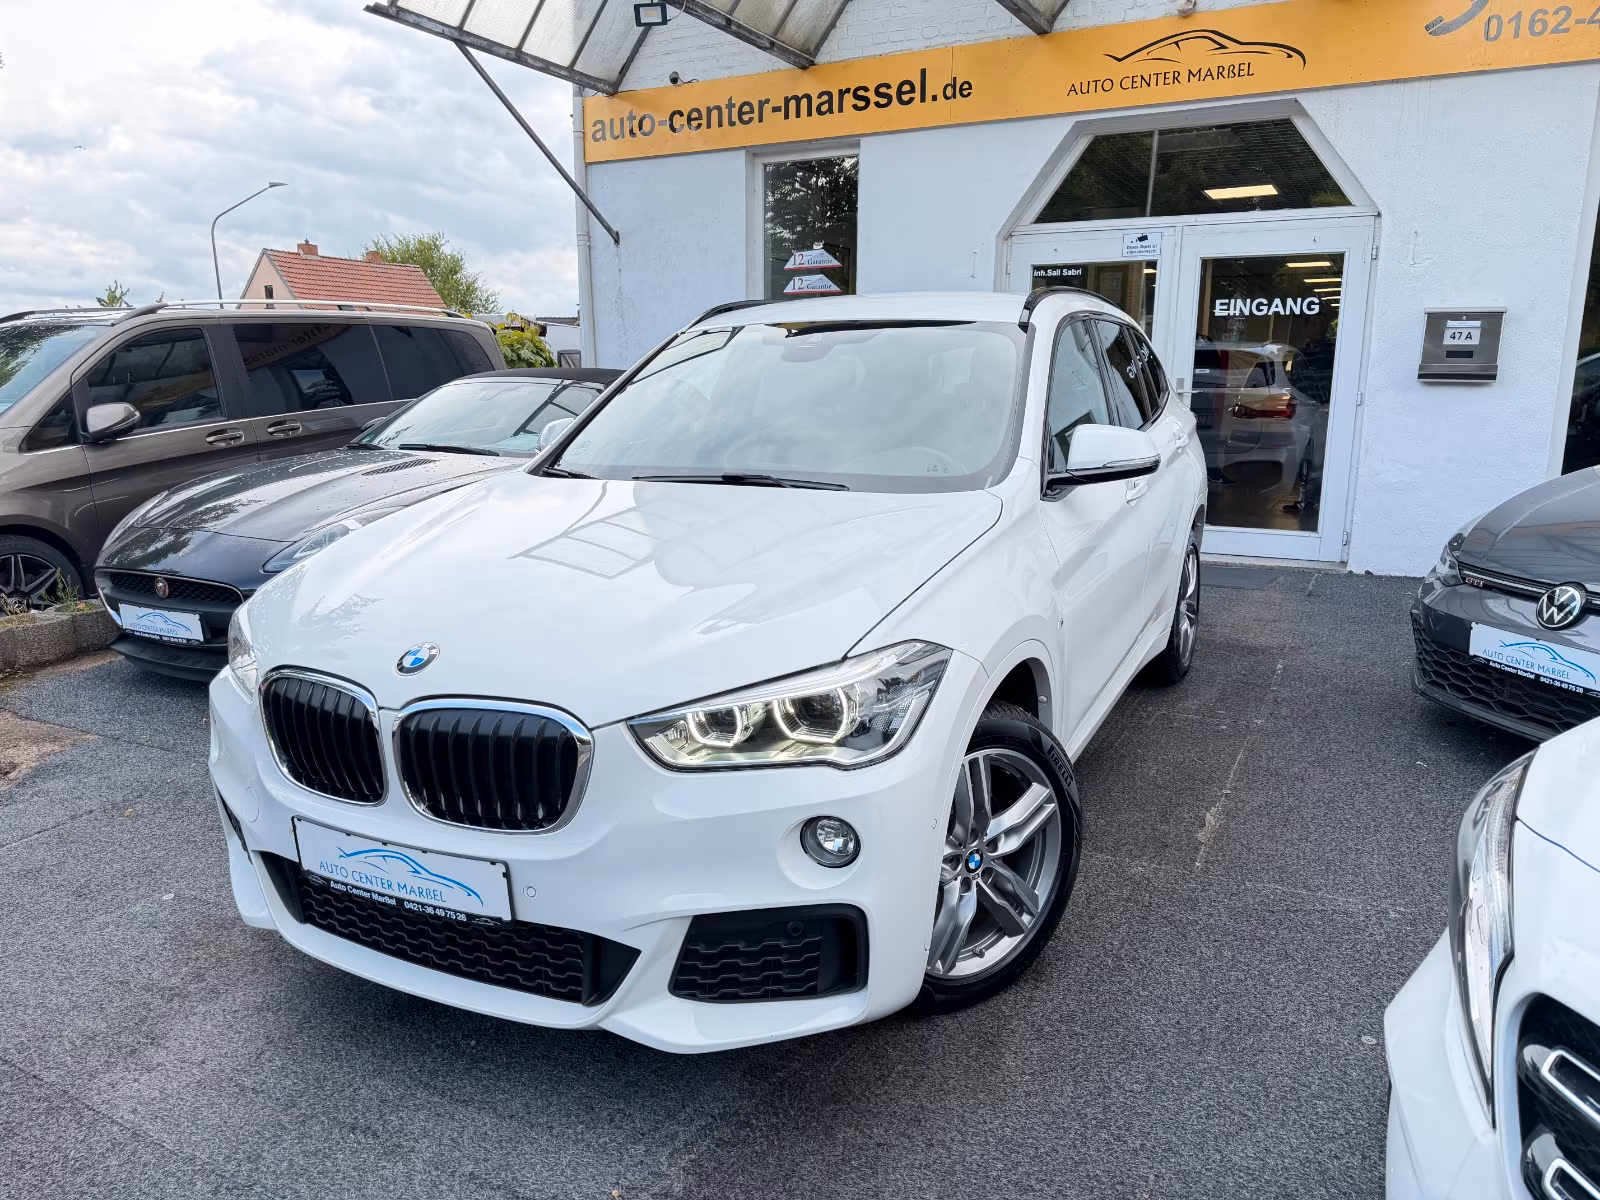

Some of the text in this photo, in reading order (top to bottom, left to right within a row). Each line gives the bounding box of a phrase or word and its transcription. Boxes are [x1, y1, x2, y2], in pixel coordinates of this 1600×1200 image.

[1066, 78, 1114, 97] AUTO
[1119, 70, 1182, 91] CENTER
[591, 67, 973, 143] auto-center-marssel.de
[792, 253, 833, 266] 12 Garantie
[1062, 267, 1082, 276] Sabri
[791, 277, 832, 291] 12 Garantie
[1214, 296, 1320, 317] EINGANG
[1449, 331, 1473, 341] 47 A
[1465, 576, 1485, 588] GTI
[1482, 648, 1504, 661] AUTO
[1505, 654, 1535, 670] CENTER
[1489, 660, 1501, 669] Auto
[1047, 744, 1074, 788] PIRELLI
[319, 860, 349, 879] AUTO
[351, 870, 395, 892] CENTER
[330, 880, 347, 892] Auto
[347, 885, 371, 899] Center
[404, 900, 435, 915] 0421-36
[435, 908, 445, 917] 49
[445, 910, 456, 920] 75
[456, 912, 467, 922] 26
